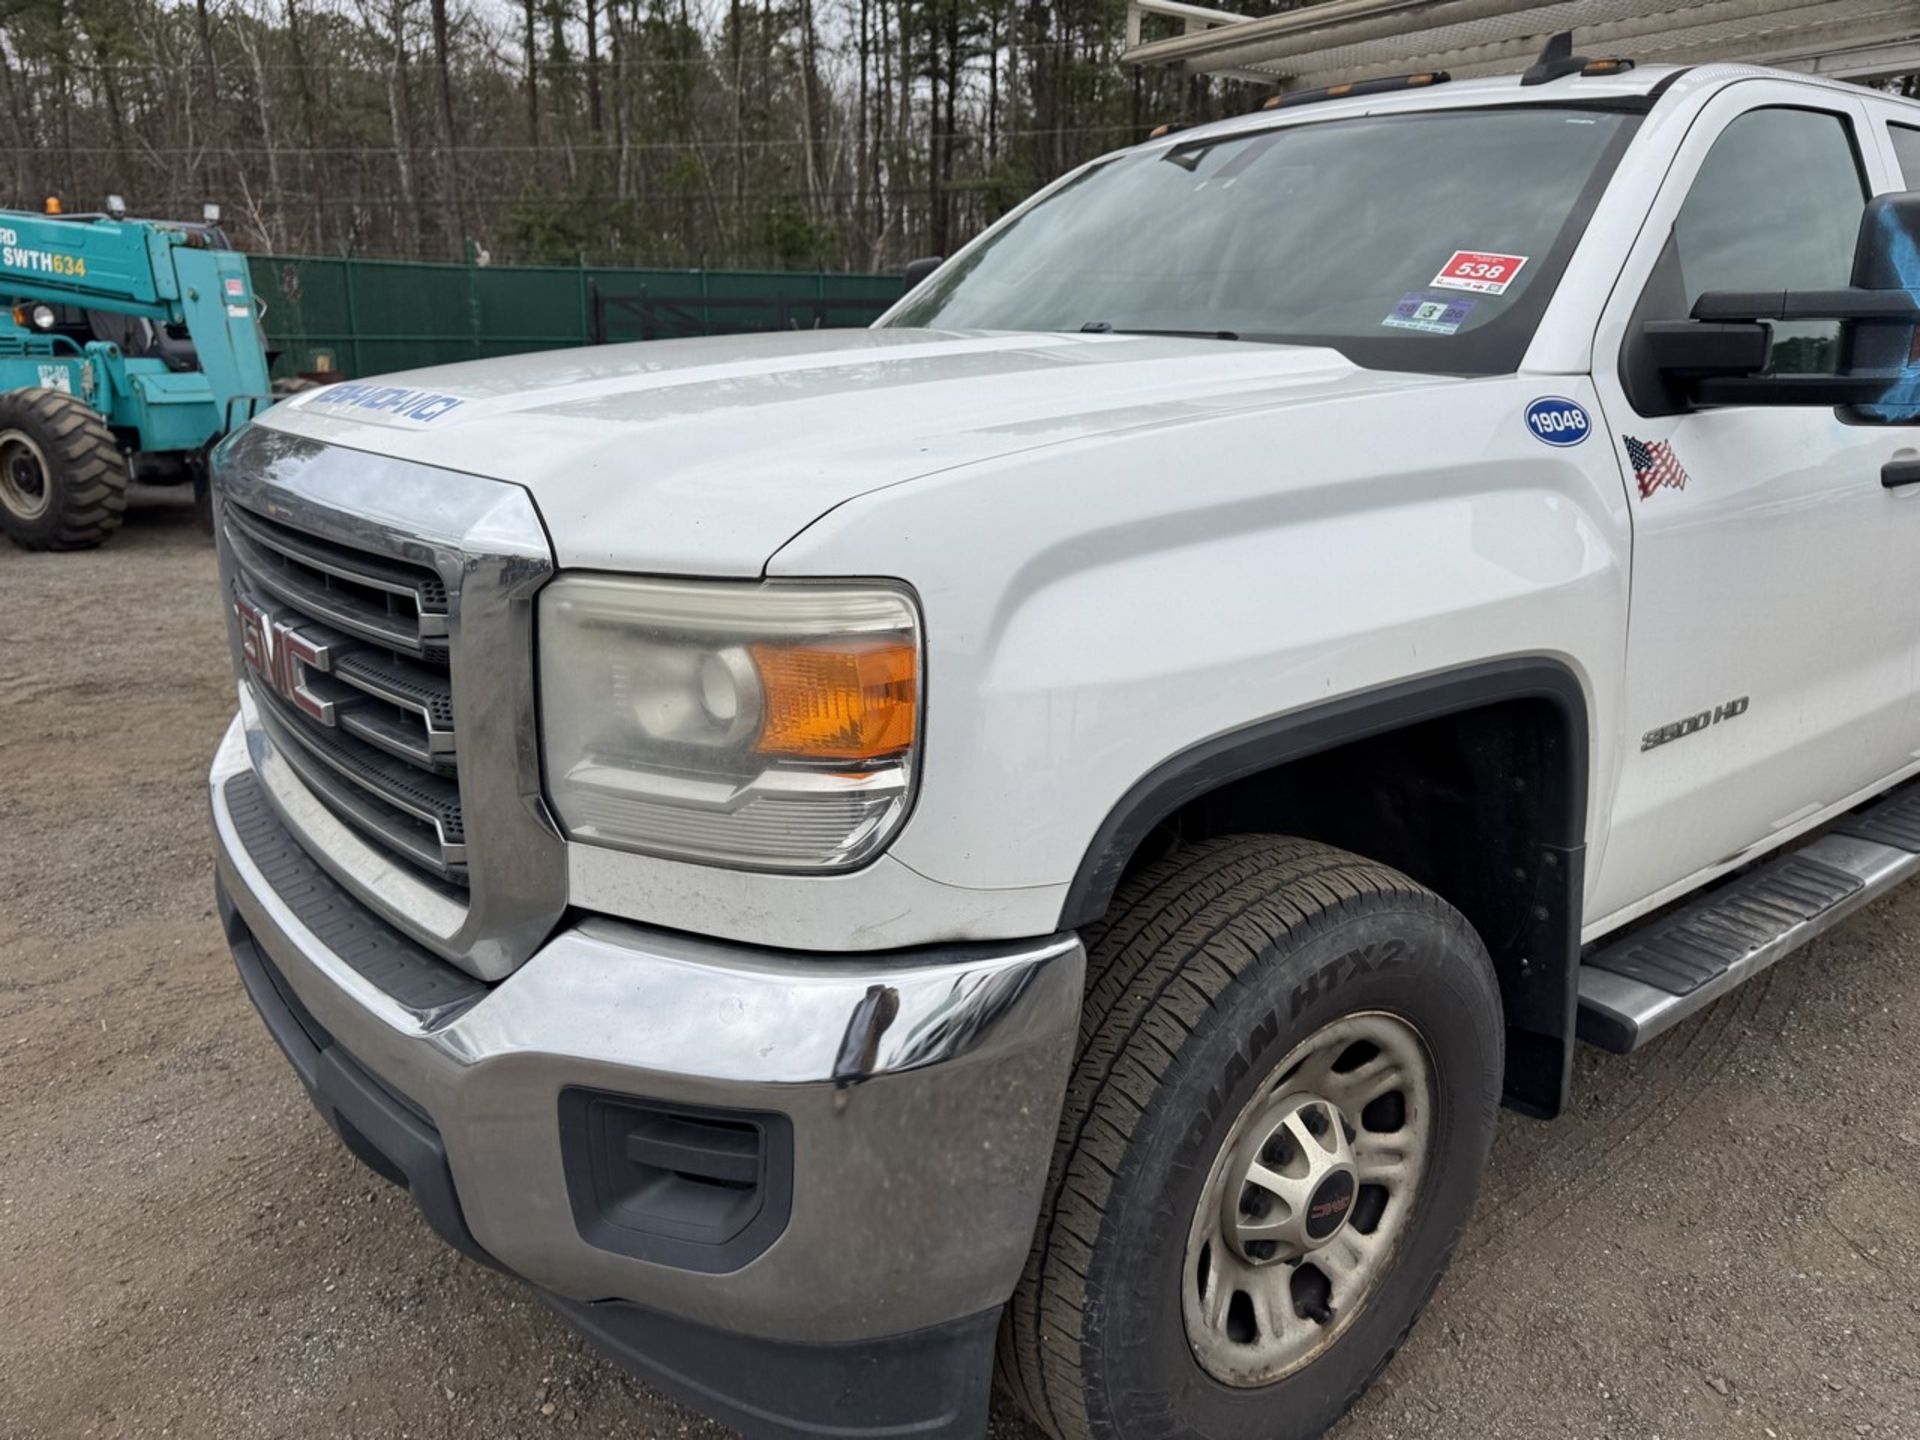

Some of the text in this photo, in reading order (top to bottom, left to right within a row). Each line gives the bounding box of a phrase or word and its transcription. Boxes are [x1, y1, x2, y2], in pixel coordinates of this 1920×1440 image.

[3, 246, 86, 278] SWTH634
[1455, 262, 1504, 279] 538
[1423, 305, 1438, 319] 3
[1531, 409, 1586, 433] 19048
[233, 600, 336, 727] GMC
[1713, 696, 1750, 725] HD
[1291, 938, 1409, 1021] HTX2
